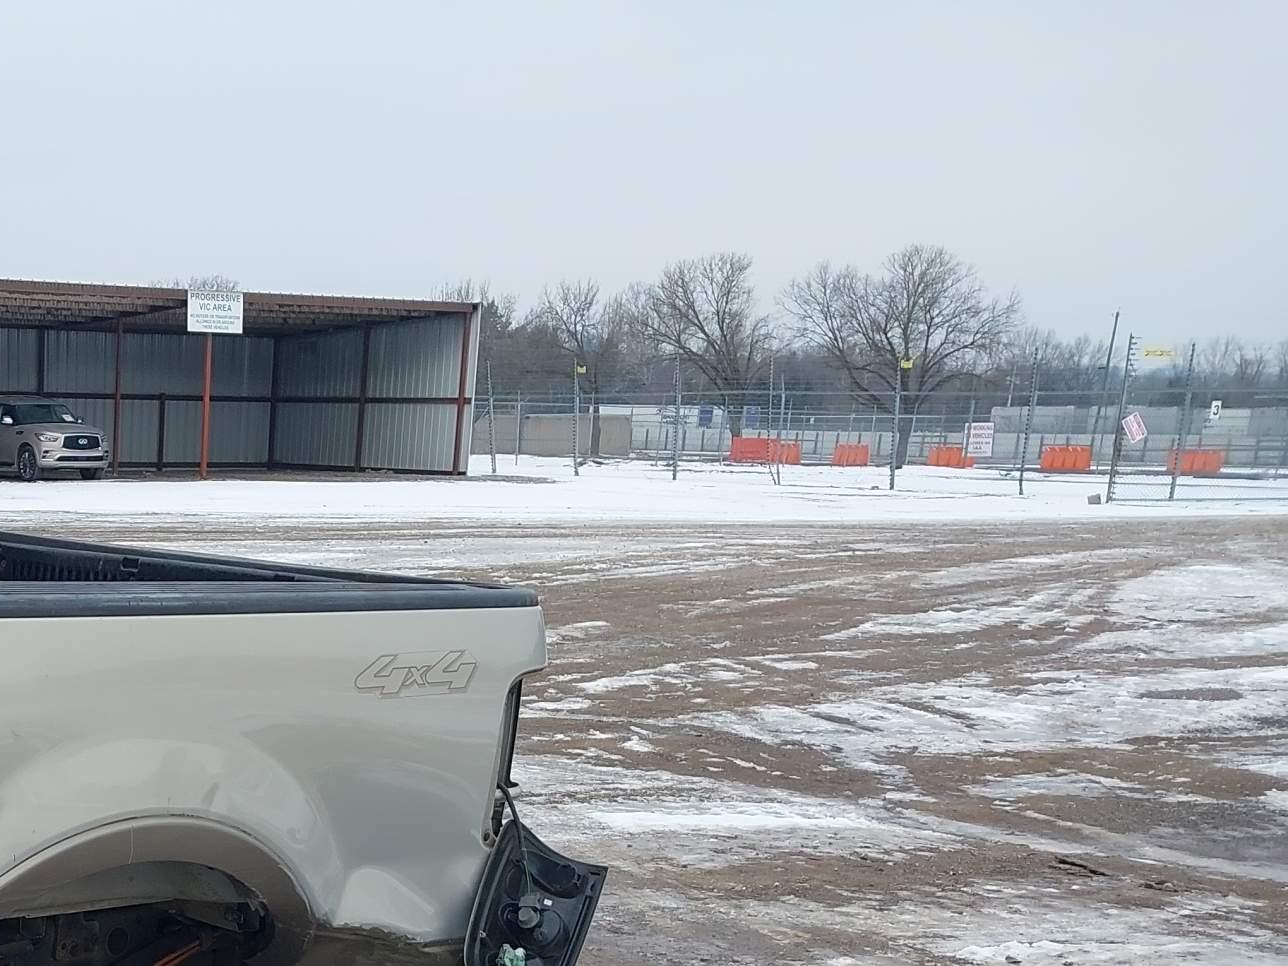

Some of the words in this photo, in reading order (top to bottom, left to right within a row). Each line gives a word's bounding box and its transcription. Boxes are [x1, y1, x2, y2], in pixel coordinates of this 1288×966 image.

[190, 292, 241, 303] PROGRESSIVE
[199, 302, 211, 311] VIC
[212, 303, 232, 312] AREA
[1212, 404, 1220, 416] 3
[354, 649, 479, 698] 4x4
